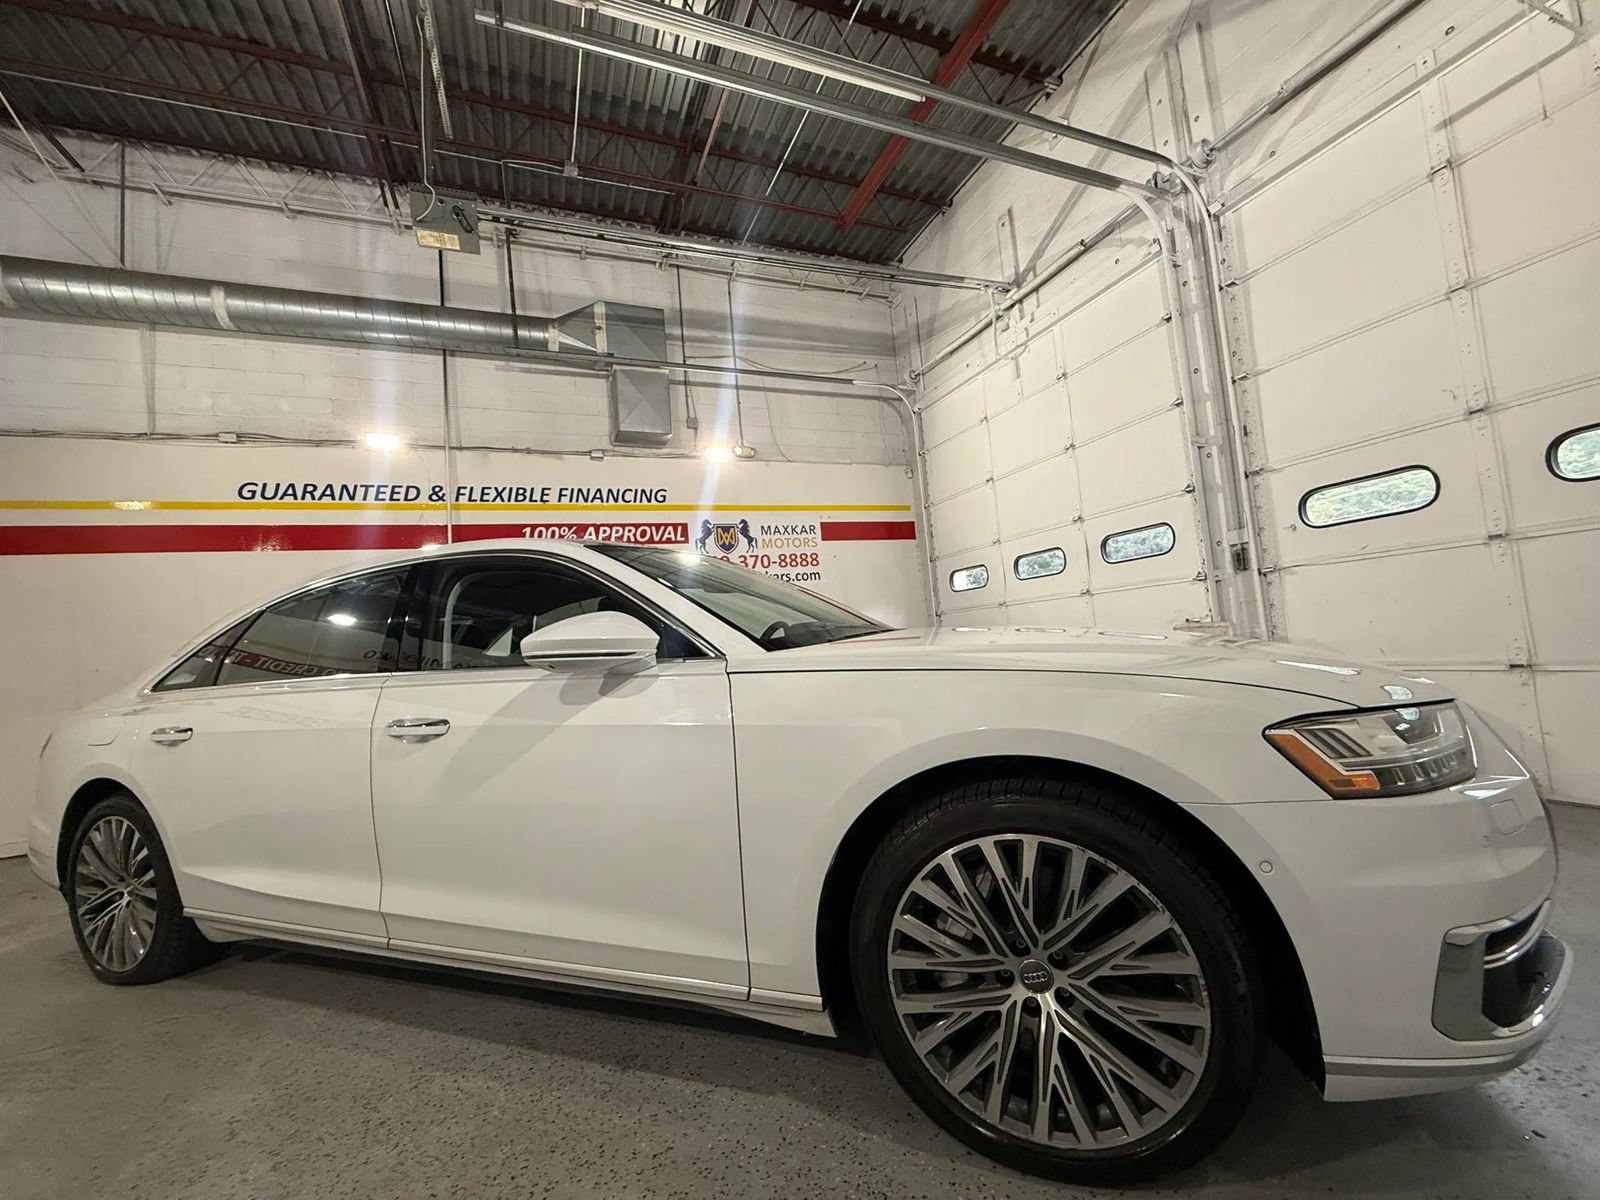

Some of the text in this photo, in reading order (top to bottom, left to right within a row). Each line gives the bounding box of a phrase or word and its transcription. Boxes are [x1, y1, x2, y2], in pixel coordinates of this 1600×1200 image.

[237, 482, 668, 503] GUARANTEED & FLEXIBLE FINANCING
[521, 525, 686, 542] 100% APPROVAL
[760, 524, 817, 535] MAXKAR
[762, 537, 818, 549] MOTORS
